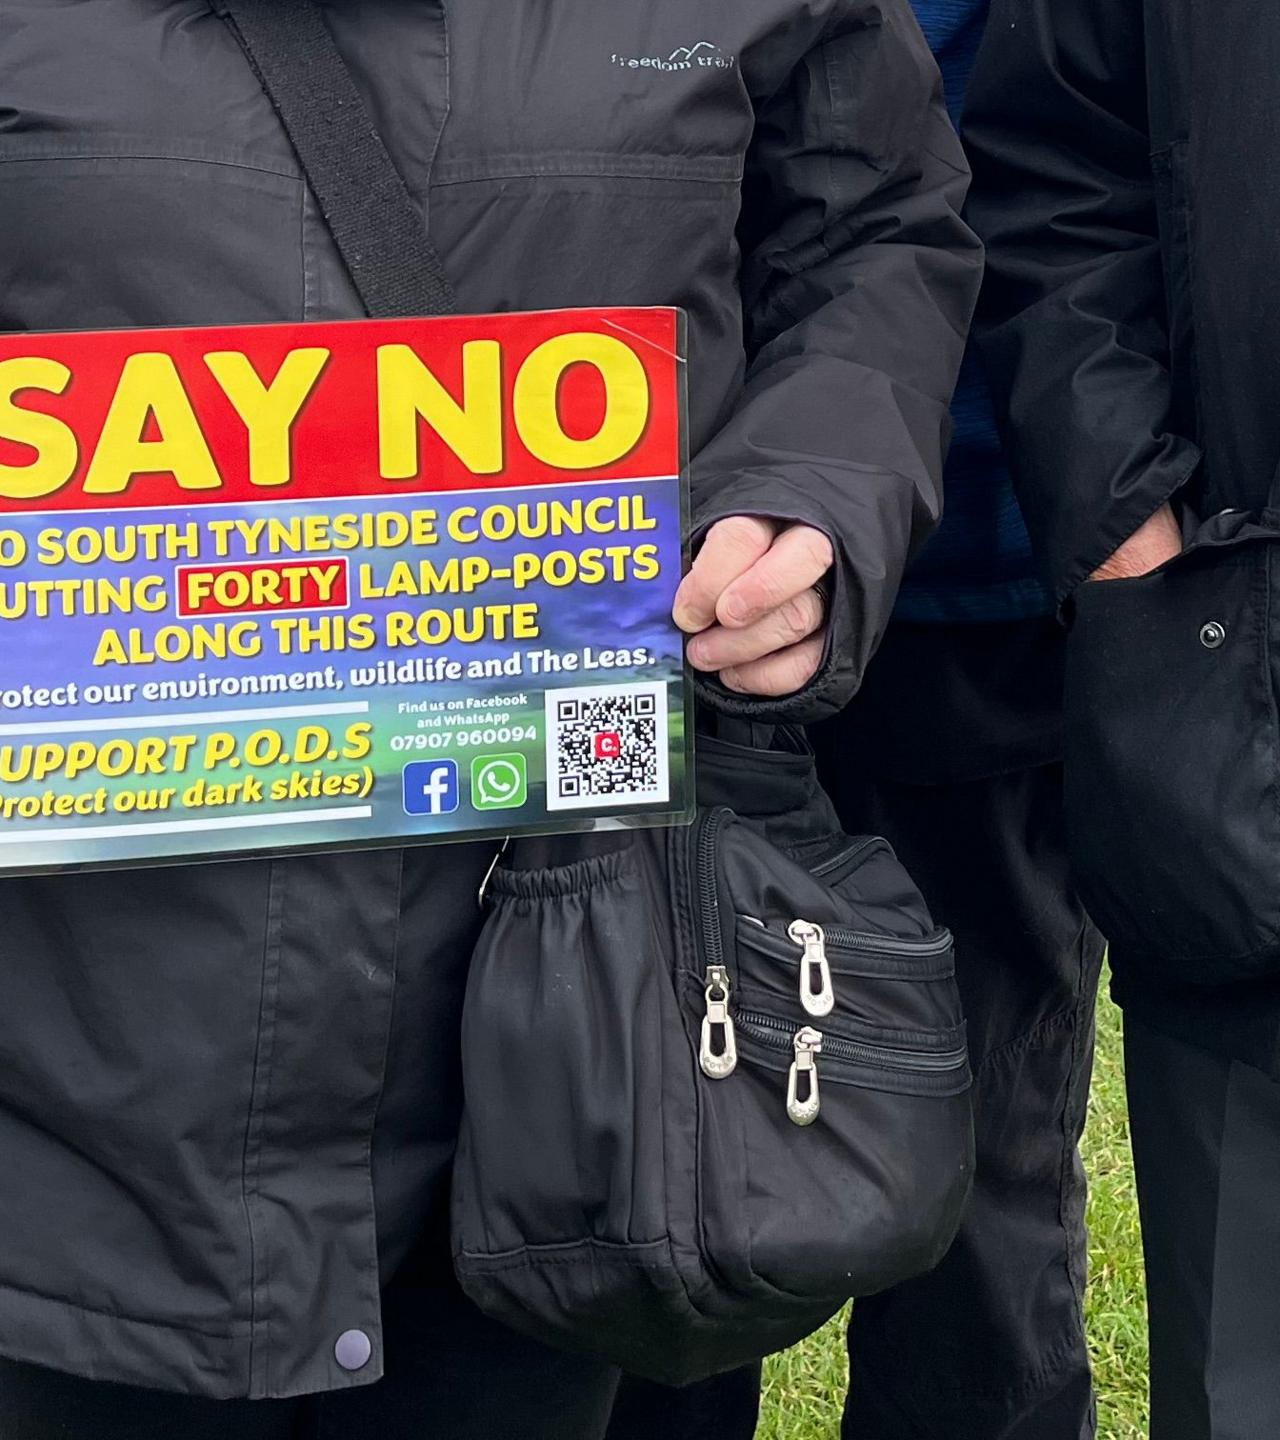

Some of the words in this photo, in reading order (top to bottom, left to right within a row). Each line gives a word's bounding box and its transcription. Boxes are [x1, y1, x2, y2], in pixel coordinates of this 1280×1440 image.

[376, 332, 649, 479] NO
[37, 522, 198, 565] SOUTH
[208, 510, 438, 555] TYNESIDE
[447, 495, 656, 543] COUNCIL
[188, 566, 340, 609] FORTY
[359, 544, 660, 598] LAMP-POSTS
[93, 621, 261, 665] ALONG
[271, 613, 376, 653] THIS
[386, 603, 539, 646] ROUTE
[83, 684, 136, 704] our
[142, 665, 345, 702] environment,
[350, 657, 462, 688] wildlife
[468, 651, 522, 678] and
[527, 648, 580, 673] The
[584, 646, 657, 671] Leas.
[397, 701, 426, 714] Find
[429, 702, 445, 712] us
[448, 700, 463, 710] on
[466, 693, 528, 709] Facebook
[417, 715, 442, 728] and
[443, 711, 510, 727] WhatsApp
[205, 723, 372, 771] P.O.D.S
[390, 731, 453, 751] 07907
[456, 724, 537, 747] 960094
[116, 788, 173, 812] our
[183, 776, 263, 808] dark
[271, 767, 374, 803] skies)
